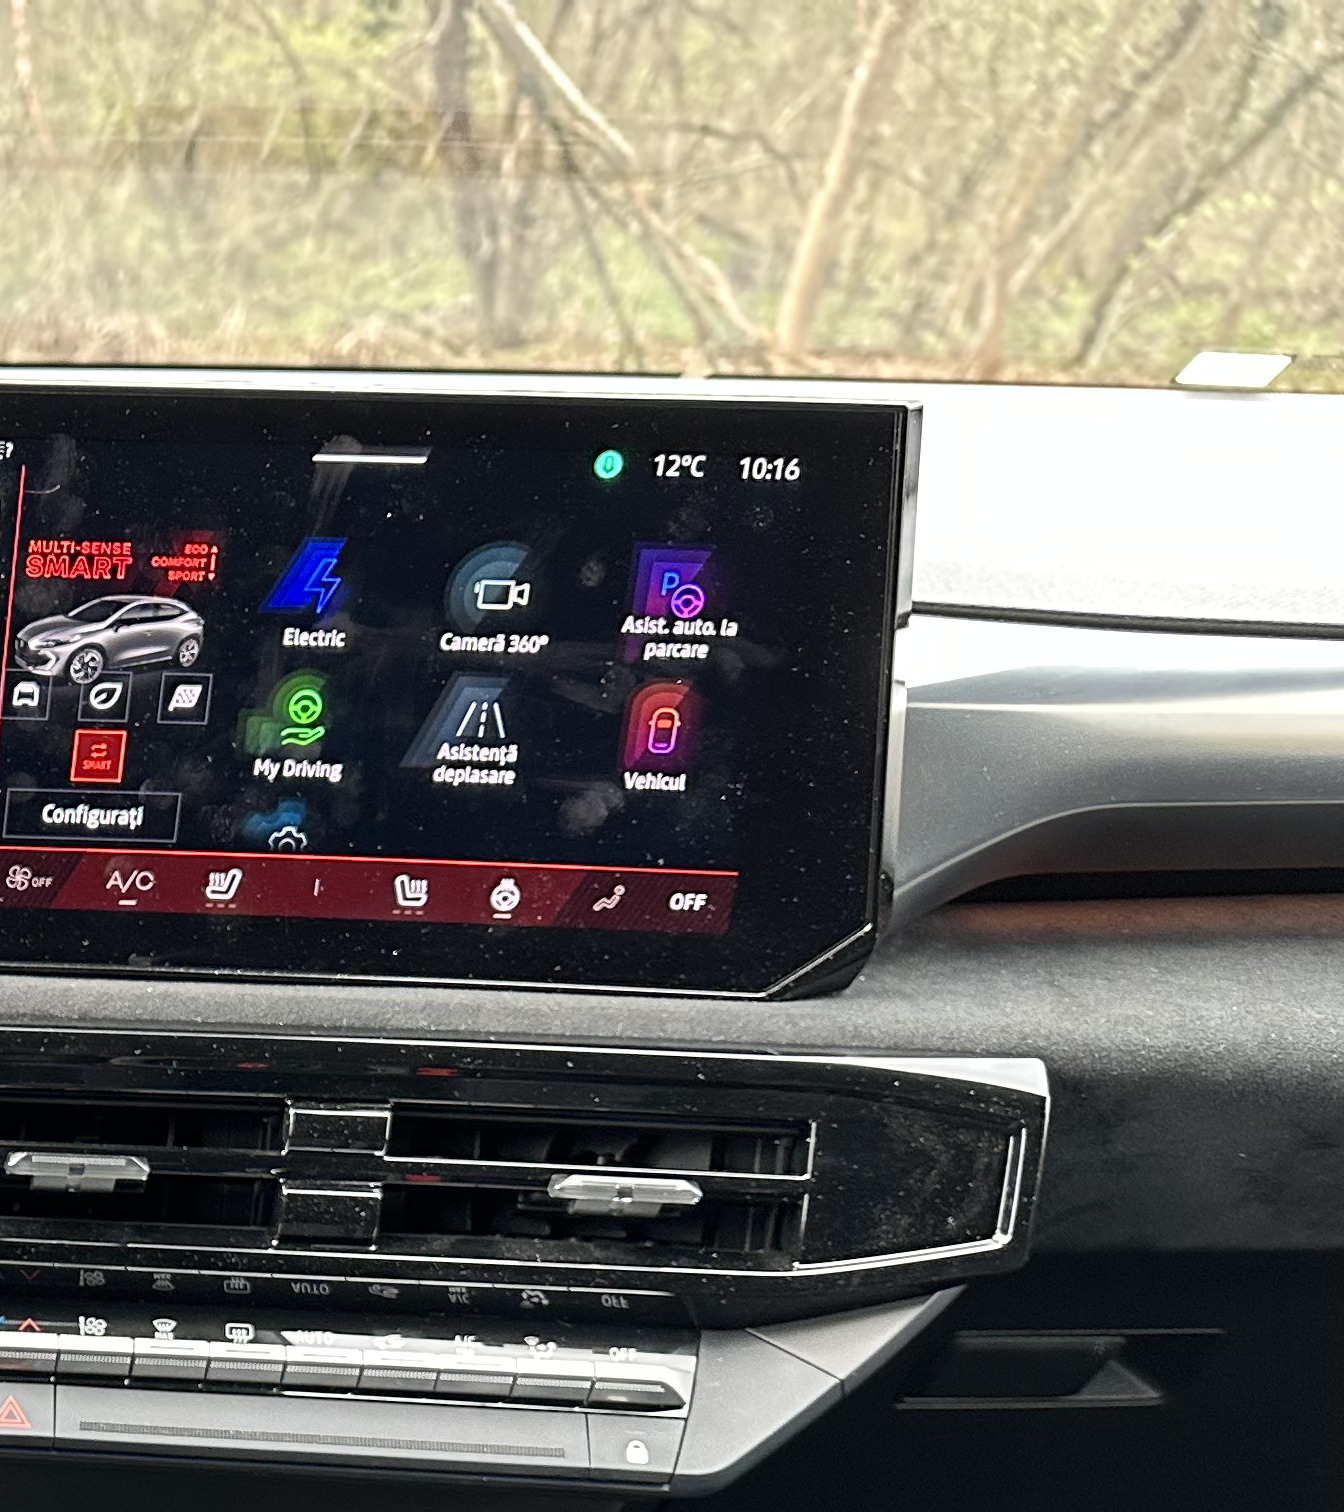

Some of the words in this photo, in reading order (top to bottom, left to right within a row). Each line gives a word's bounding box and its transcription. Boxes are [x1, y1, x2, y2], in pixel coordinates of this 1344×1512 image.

[738, 456, 801, 481] 10:16
[28, 539, 132, 555] MULTI-SENSE
[184, 543, 209, 555] ECO
[25, 554, 134, 580] SMART
[151, 555, 208, 568] COMFORT
[168, 569, 206, 582] SPORT
[621, 616, 670, 636] Asist.
[670, 618, 717, 637] auto.
[720, 618, 738, 637] la
[282, 627, 346, 649] Electric
[439, 631, 507, 653] Cameră
[643, 642, 709, 661] parcare
[252, 758, 279, 779] My
[281, 759, 343, 783] Driving
[432, 764, 517, 788] deplasare
[623, 771, 687, 792] Vehicul
[31, 876, 54, 889] OFF
[105, 868, 156, 894] A/C
[668, 891, 708, 912] OFF
[608, 1346, 638, 1362] OFF
